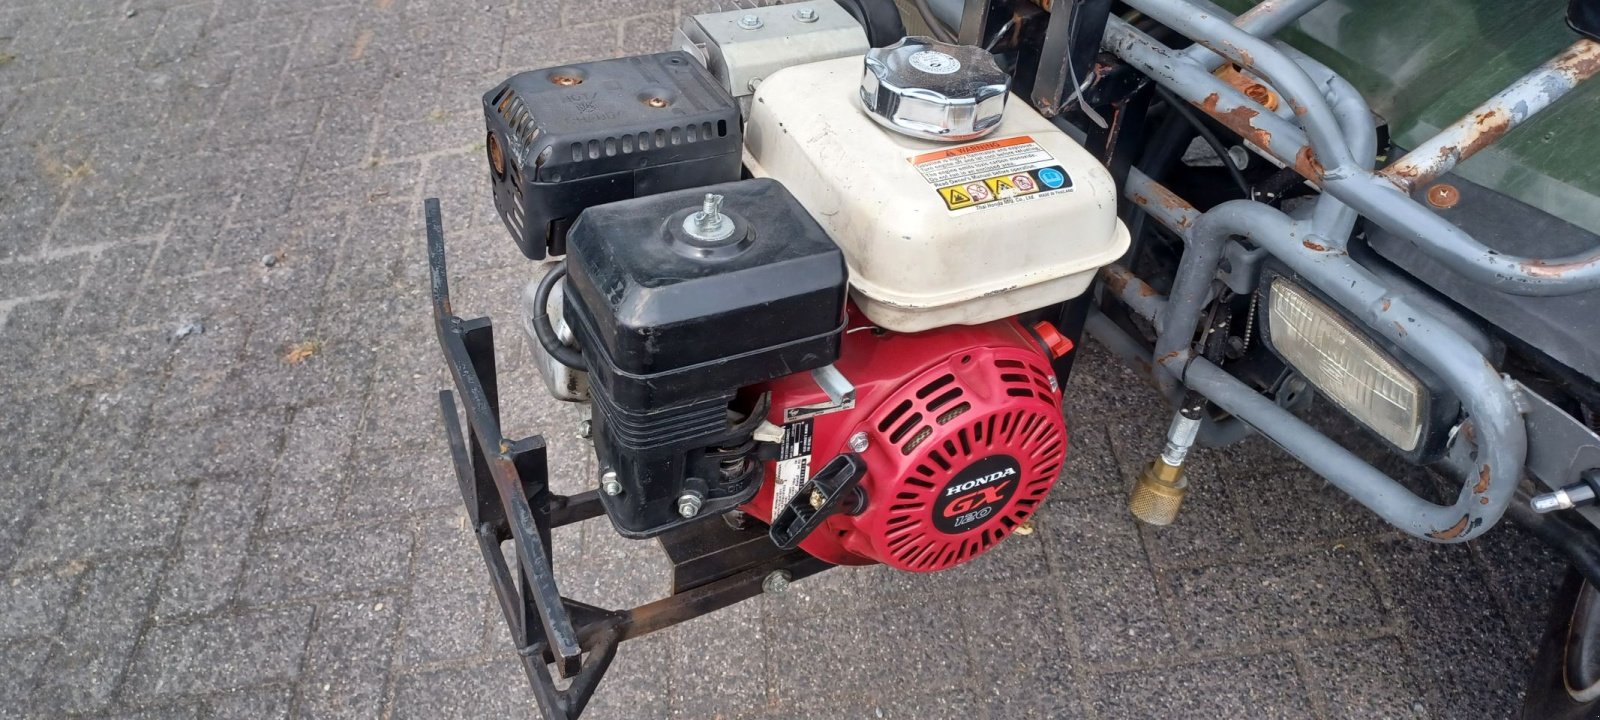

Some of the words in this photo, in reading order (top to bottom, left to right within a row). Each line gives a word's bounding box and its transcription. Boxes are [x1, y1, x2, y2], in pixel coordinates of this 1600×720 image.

[946, 468, 1016, 496] HONDA
[944, 480, 1012, 517] GX
[954, 506, 992, 527] 120
